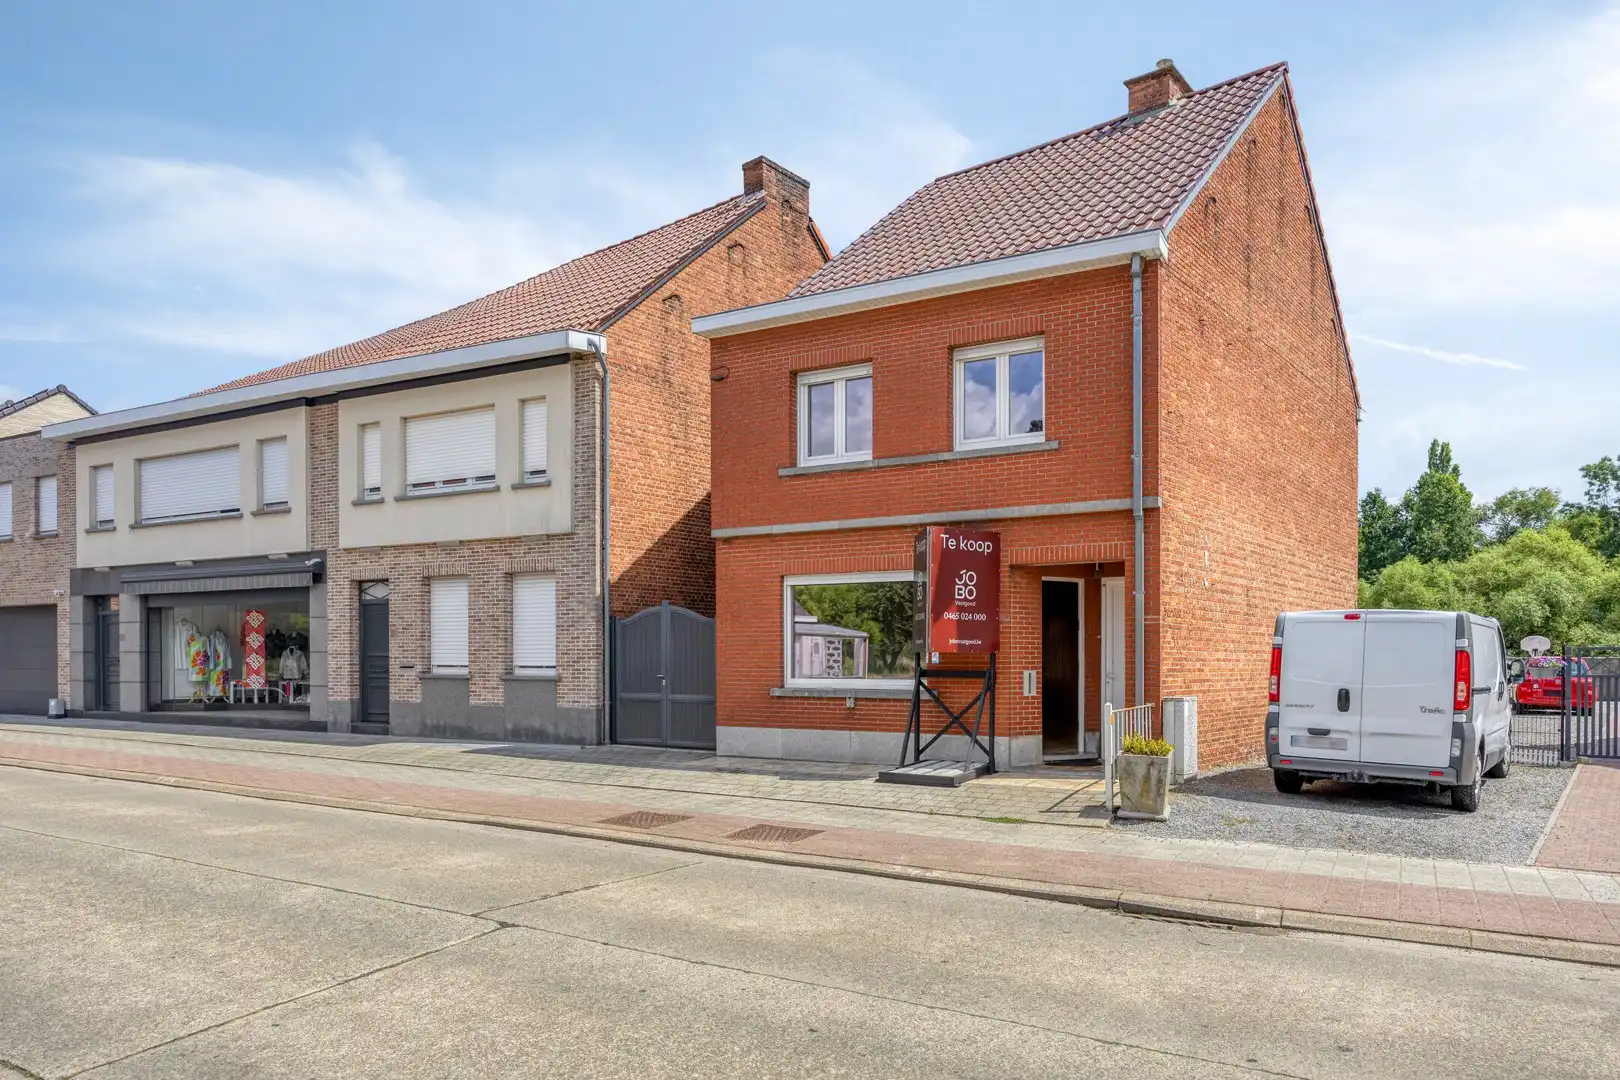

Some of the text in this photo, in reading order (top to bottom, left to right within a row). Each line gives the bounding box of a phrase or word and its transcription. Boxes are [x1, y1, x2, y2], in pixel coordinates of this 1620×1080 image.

[940, 534, 956, 549] Te
[960, 535, 993, 556] koop
[954, 585, 977, 600] BO
[943, 611, 987, 621] 0465 024 000
